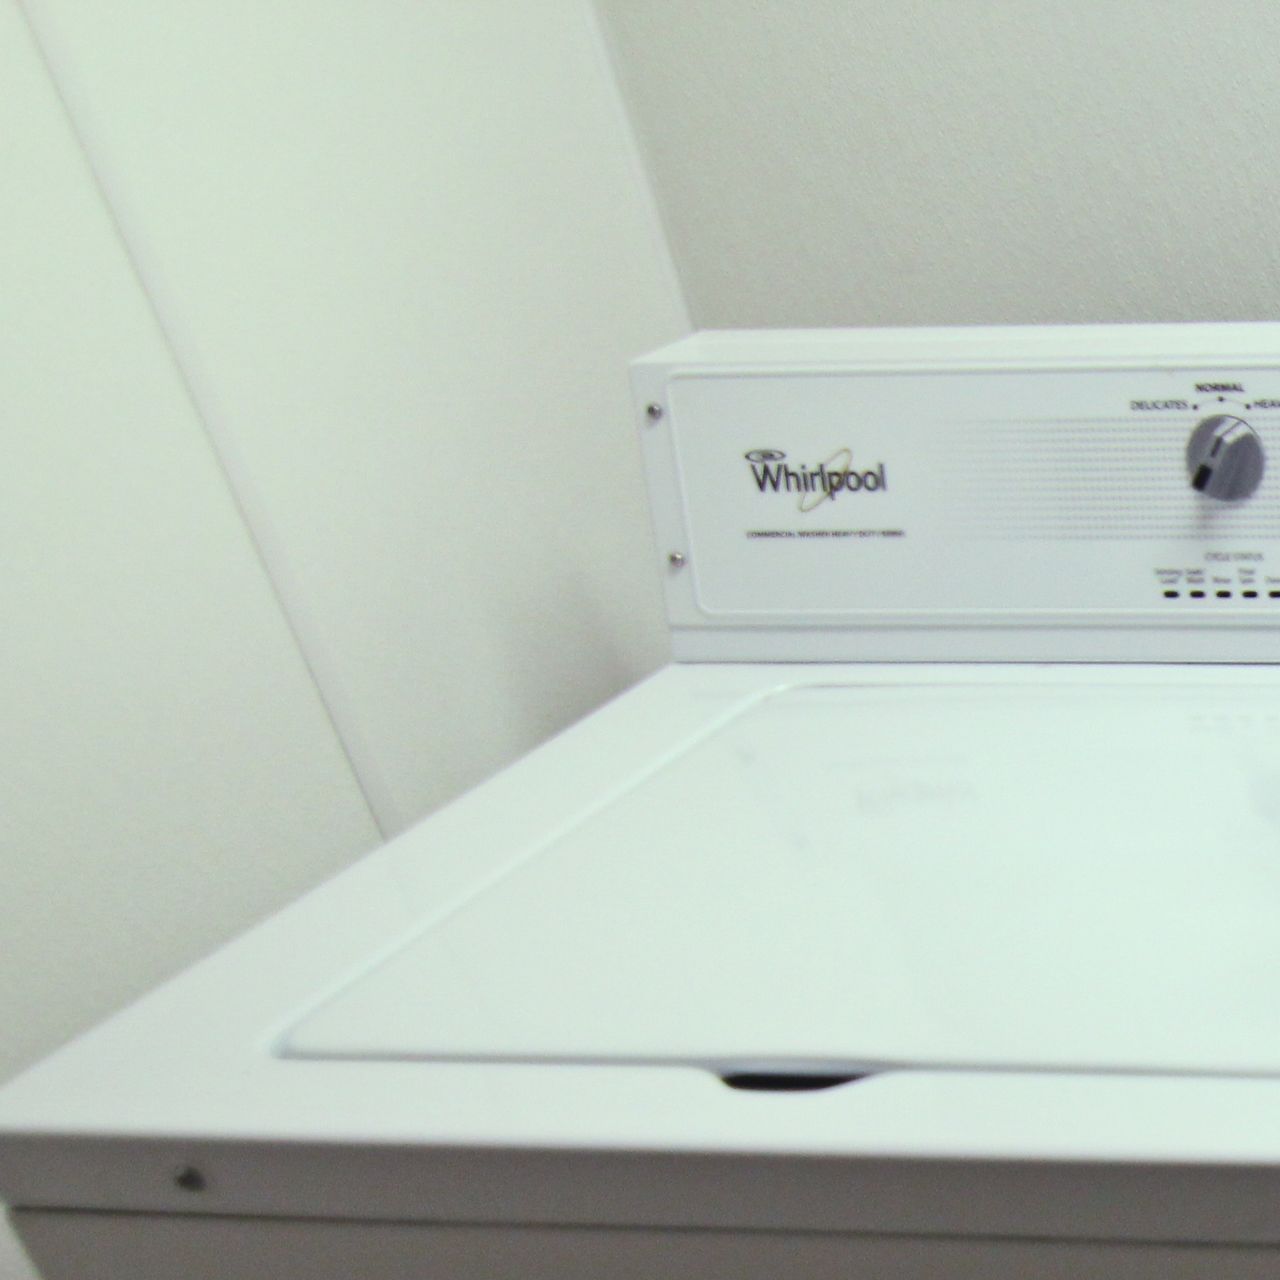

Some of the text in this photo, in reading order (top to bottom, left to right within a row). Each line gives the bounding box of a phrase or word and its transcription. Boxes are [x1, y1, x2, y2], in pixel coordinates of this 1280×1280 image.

[1195, 382, 1244, 394] NORMAL
[1130, 400, 1188, 411] DELICATES
[750, 462, 888, 502] Whirlpool
